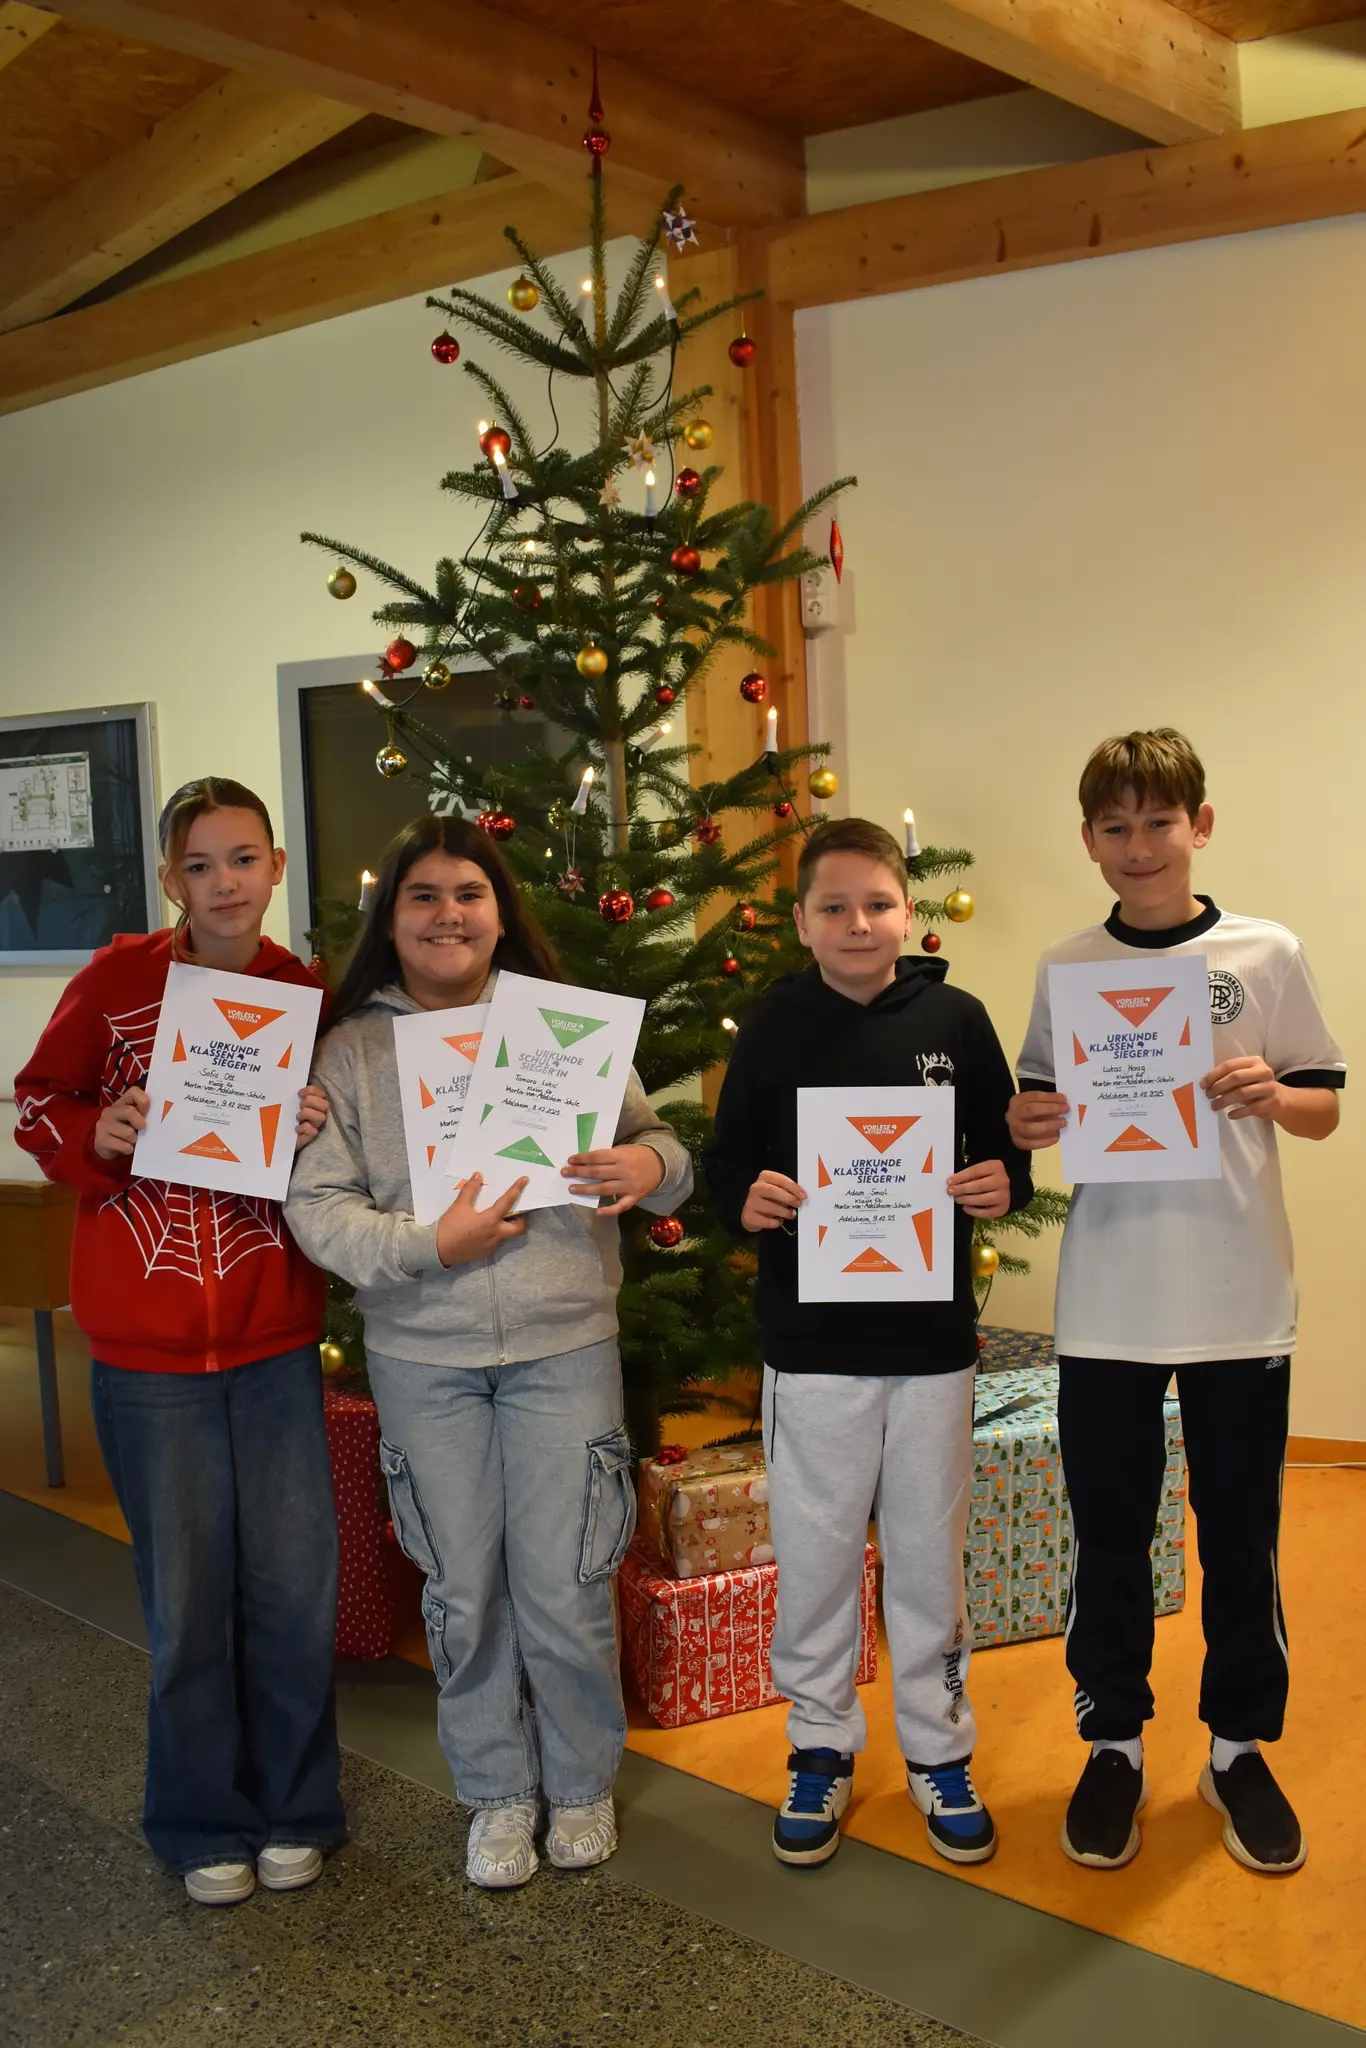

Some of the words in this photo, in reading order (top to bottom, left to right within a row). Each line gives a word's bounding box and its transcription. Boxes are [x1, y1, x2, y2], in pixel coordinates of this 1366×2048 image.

[227, 1009, 255, 1019] VORLESE
[551, 1018, 579, 1029] VORLESE
[1107, 1032, 1158, 1043] URKUNDE
[189, 1045, 235, 1060] KLASSEN
[209, 1040, 260, 1056] URKUNDE
[1089, 1042, 1134, 1052] KLASSEN
[518, 1053, 551, 1067] SCHUL
[535, 1048, 585, 1066] URKUNDE
[198, 1068, 219, 1079] Sofia
[224, 1072, 235, 1081] Ott
[1102, 1065, 1122, 1073] Lukas
[515, 1073, 537, 1085] Tamara
[851, 1158, 902, 1167] URKUNDE
[833, 1167, 878, 1176] KLASSEN
